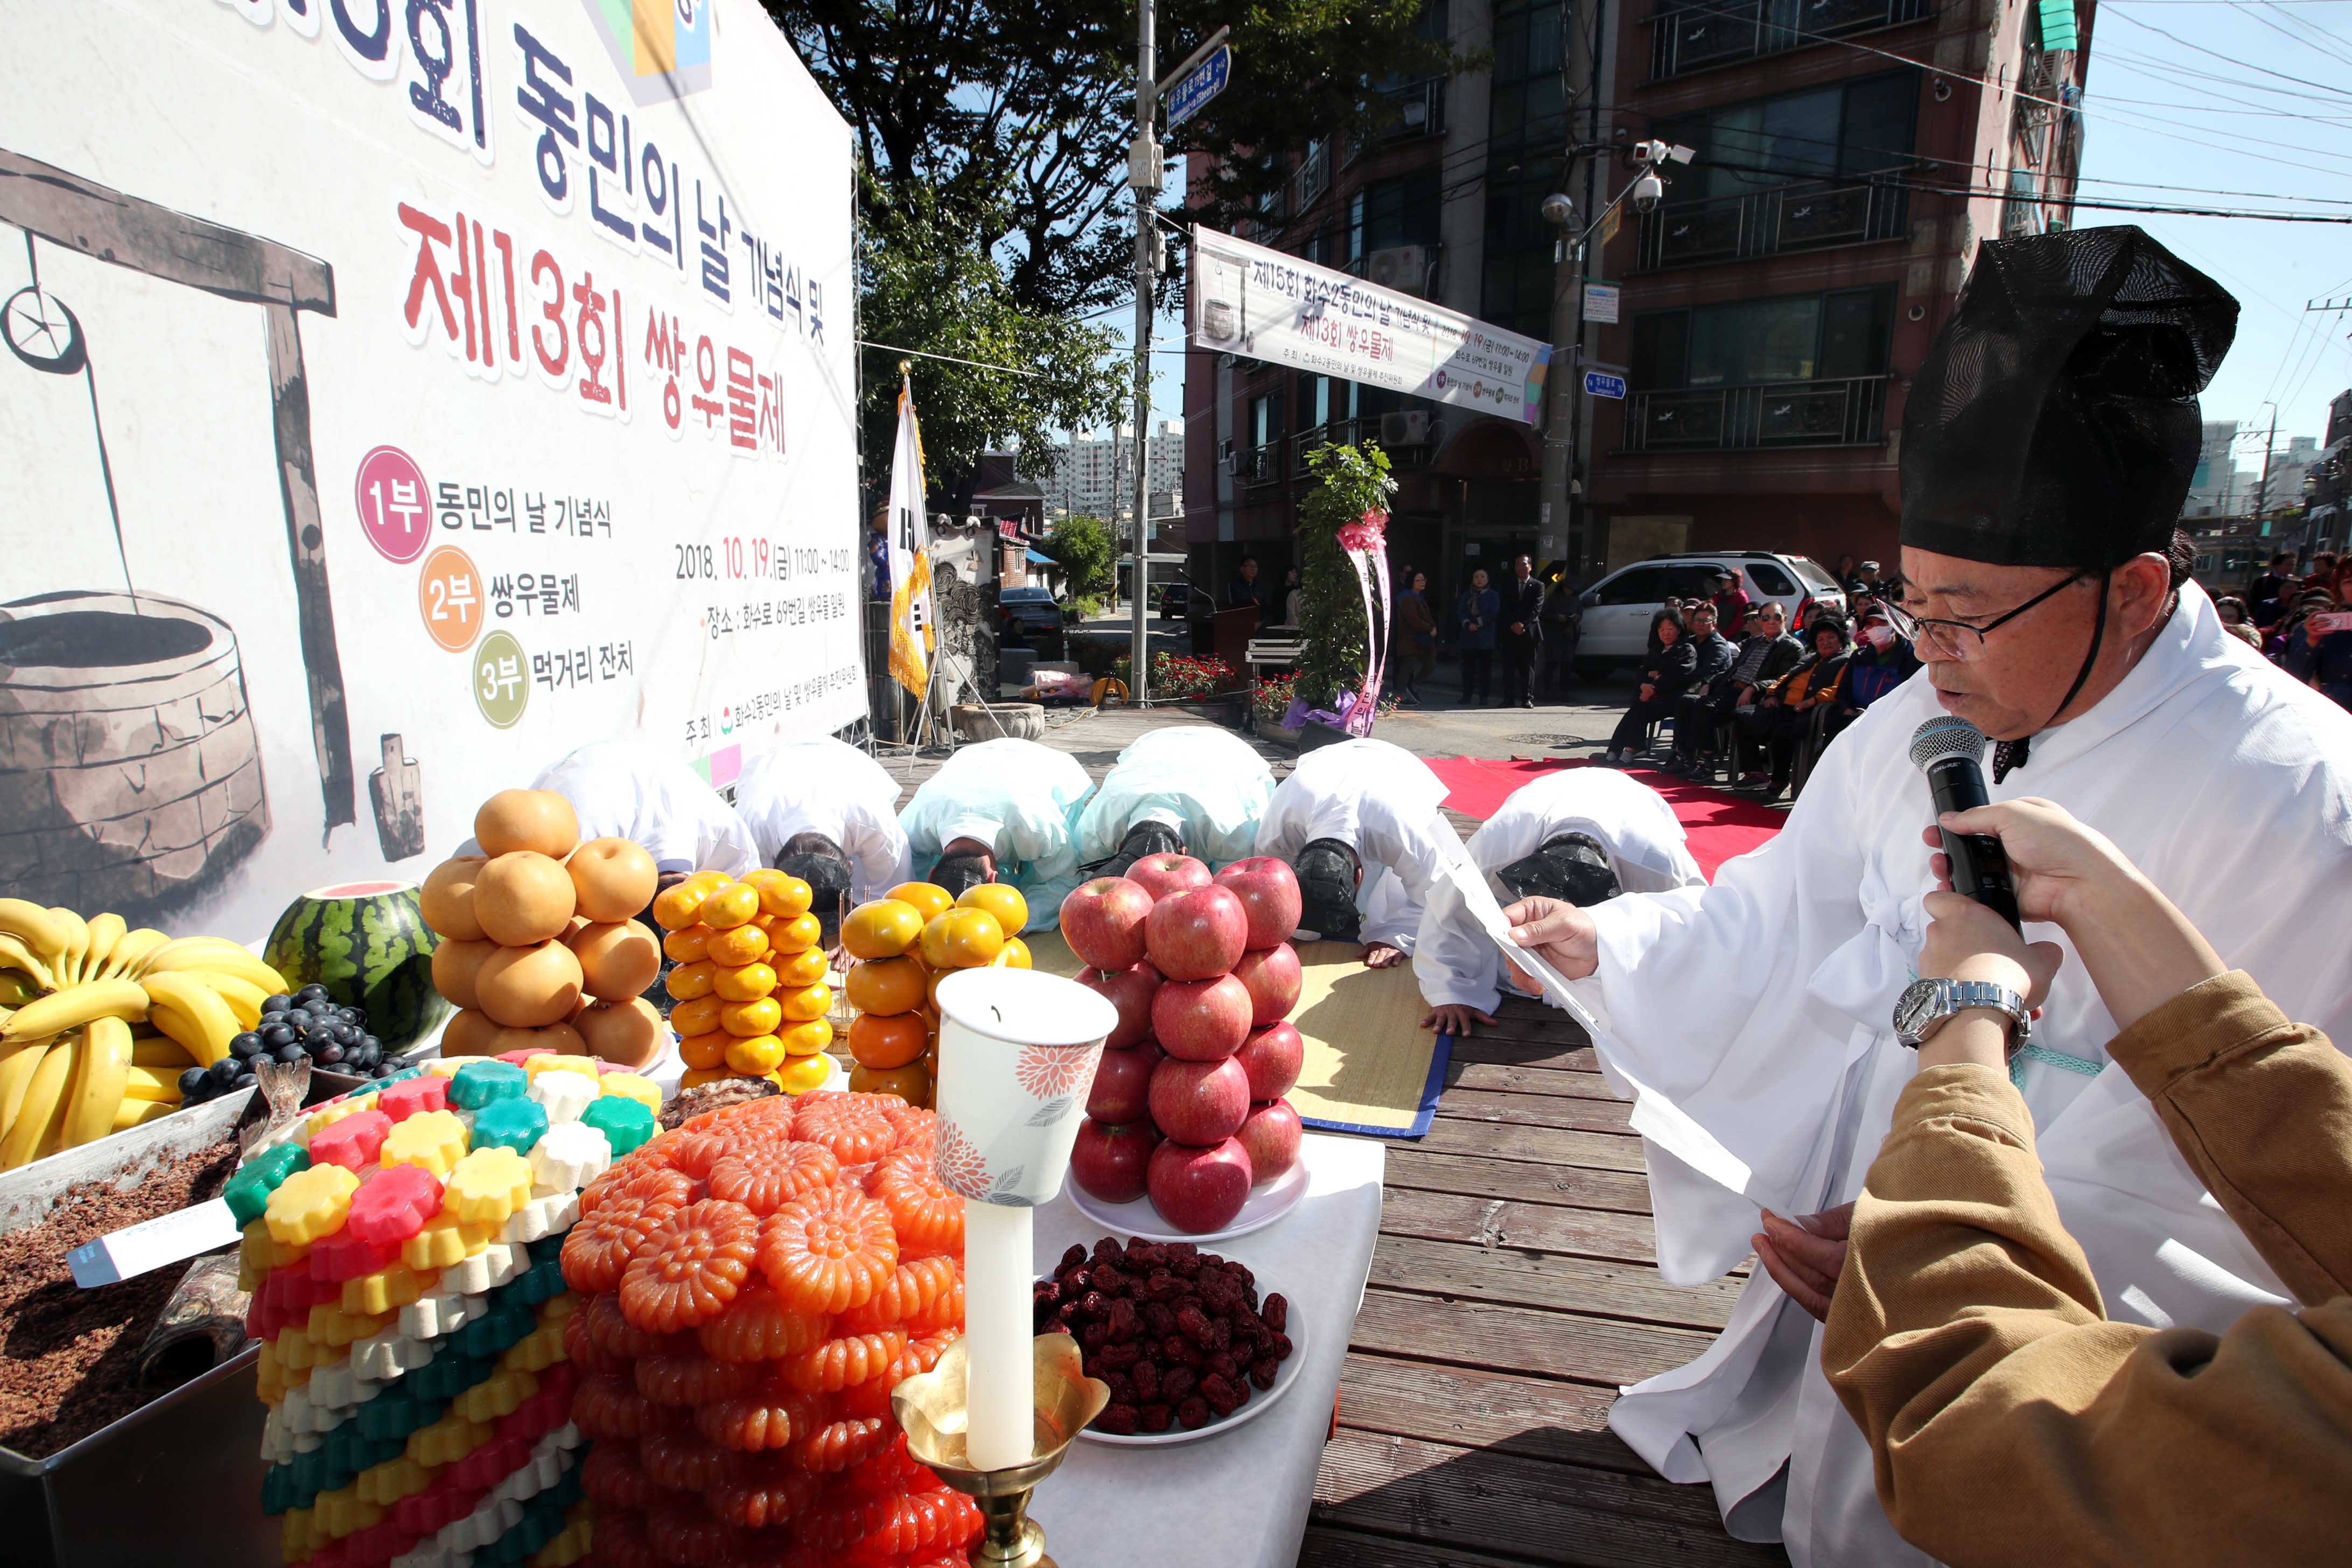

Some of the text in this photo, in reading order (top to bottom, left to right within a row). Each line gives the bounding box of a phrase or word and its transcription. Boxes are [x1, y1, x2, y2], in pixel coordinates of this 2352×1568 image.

[513, 22, 685, 271] 동민의
[697, 178, 731, 305] 날
[741, 232, 803, 335] 기념식
[809, 279, 824, 346] 및
[1254, 261, 1431, 335] 제15회 화수2동민의 날 기념식 및
[398, 201, 786, 453] 제13회 쌍우물제
[1301, 314, 1394, 362] 제13회 쌍우물제
[1310, 354, 1342, 370] 화수2동민의
[1343, 362, 1350, 373] 날
[1351, 365, 1356, 375] 및
[1357, 366, 1378, 380] 쌍우물제
[1379, 372, 1403, 386] 추진위원회
[370, 478, 612, 538] 1부 동민의 날 기념식
[675, 543, 718, 581] 2018.
[795, 548, 818, 575] 11:00
[830, 548, 849, 574] 14:00
[429, 572, 580, 624] 2부 쌍우물제
[743, 602, 773, 631] 화수로
[776, 597, 806, 626] 69번길
[808, 594, 829, 623] 쌍우물
[831, 592, 845, 618] 일원
[482, 640, 634, 701] 3부 먹거리 잔치
[735, 689, 781, 728] 화수2동민의
[784, 688, 792, 710] 날
[794, 683, 801, 706] 및
[803, 673, 828, 703] 쌍우물제
[829, 664, 858, 690] 추진위원회
[1933, 762, 1959, 774] SHURE
